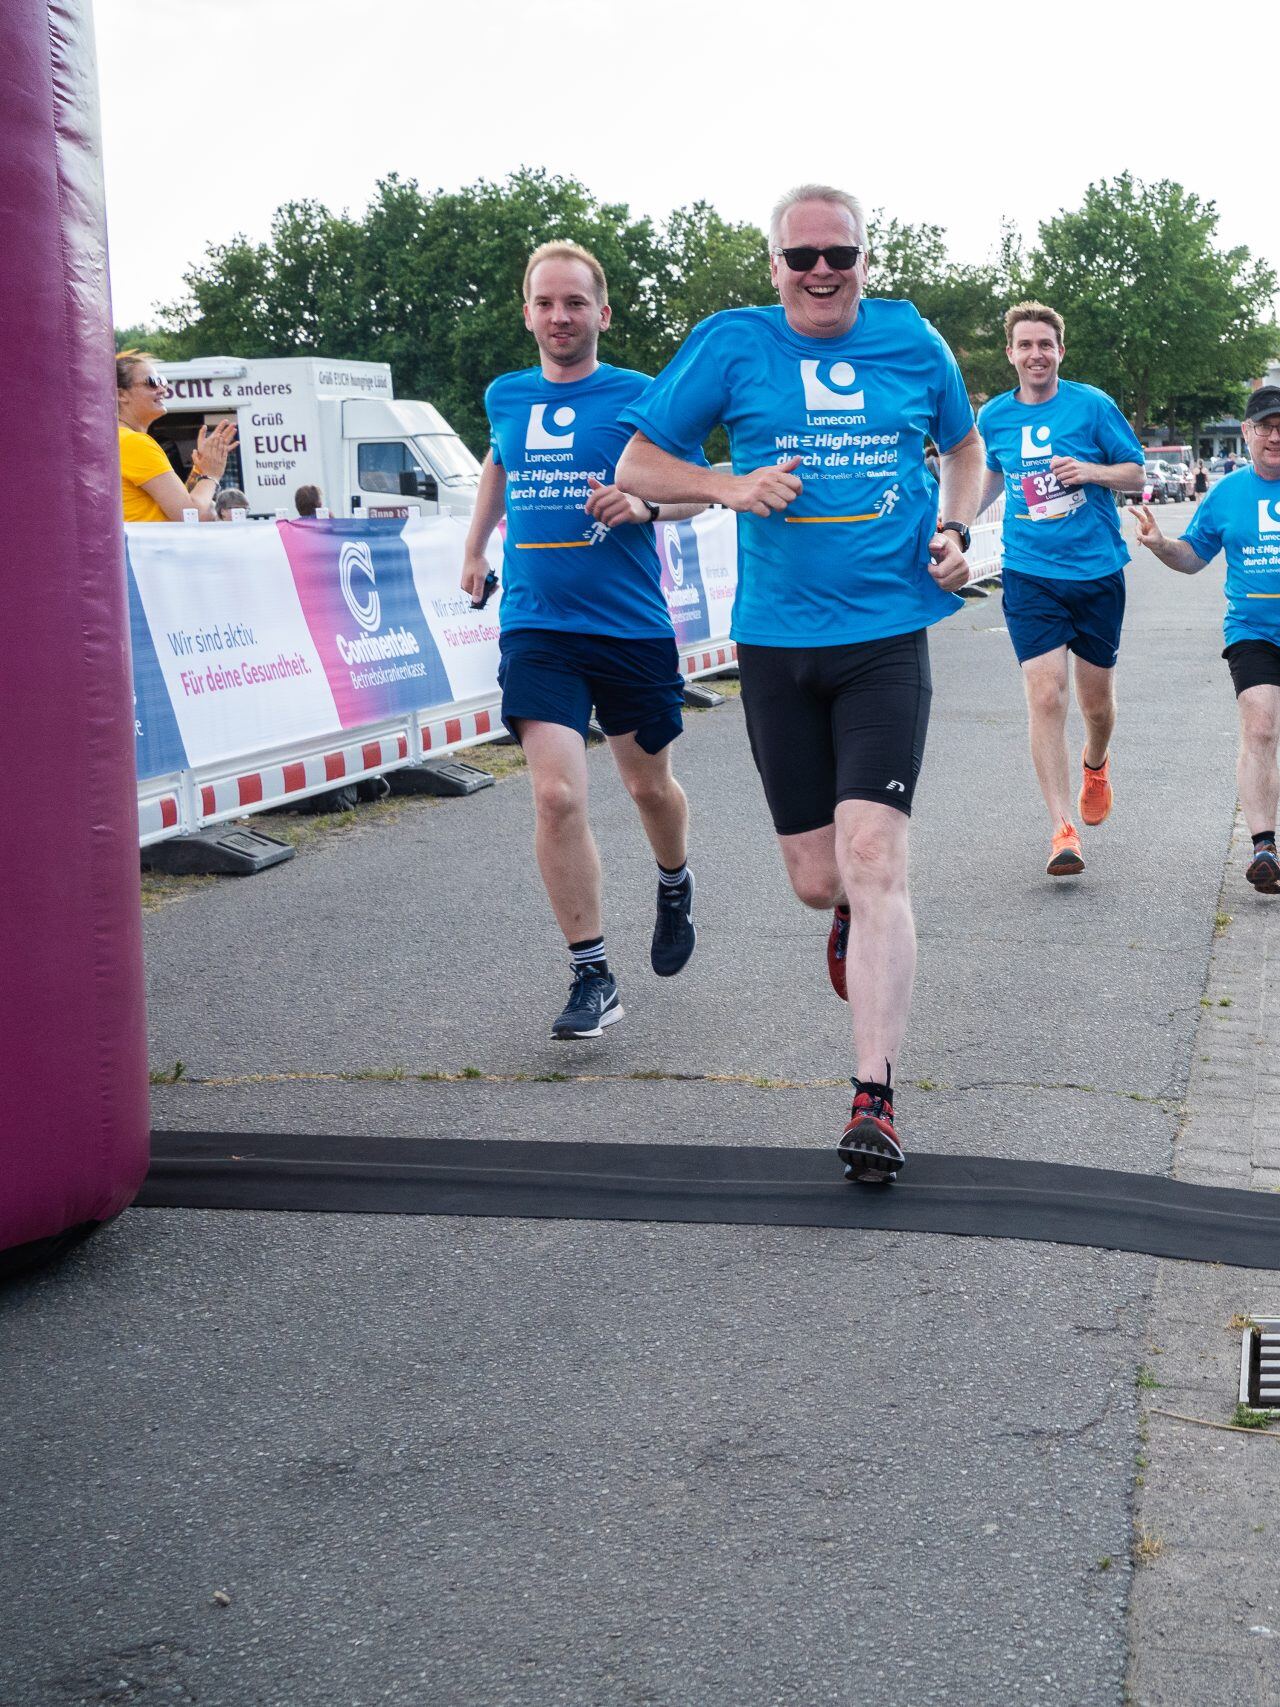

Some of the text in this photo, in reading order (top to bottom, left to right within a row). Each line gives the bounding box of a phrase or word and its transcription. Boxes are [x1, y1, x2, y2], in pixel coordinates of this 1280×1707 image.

[223, 384, 232, 396] &
[237, 382, 292, 396] anderes
[252, 413, 284, 426] Grüß
[254, 434, 307, 454] EUCH
[775, 432, 900, 450] Mit Highspeed
[256, 459, 296, 470] hungrige
[776, 450, 898, 466] dch die Heide!
[258, 474, 286, 486] Lüüd
[531, 469, 606, 484] Highspeed
[539, 486, 560, 498] die
[1033, 473, 1069, 496] 32
[1242, 546, 1256, 554] Mit
[1244, 557, 1268, 566] durch
[167, 622, 258, 656] Wir sind aktiv.
[336, 626, 420, 666] Continentale
[180, 652, 312, 696] Für deine Gesundheit.
[350, 661, 428, 690] Betriebskrankenkasse
